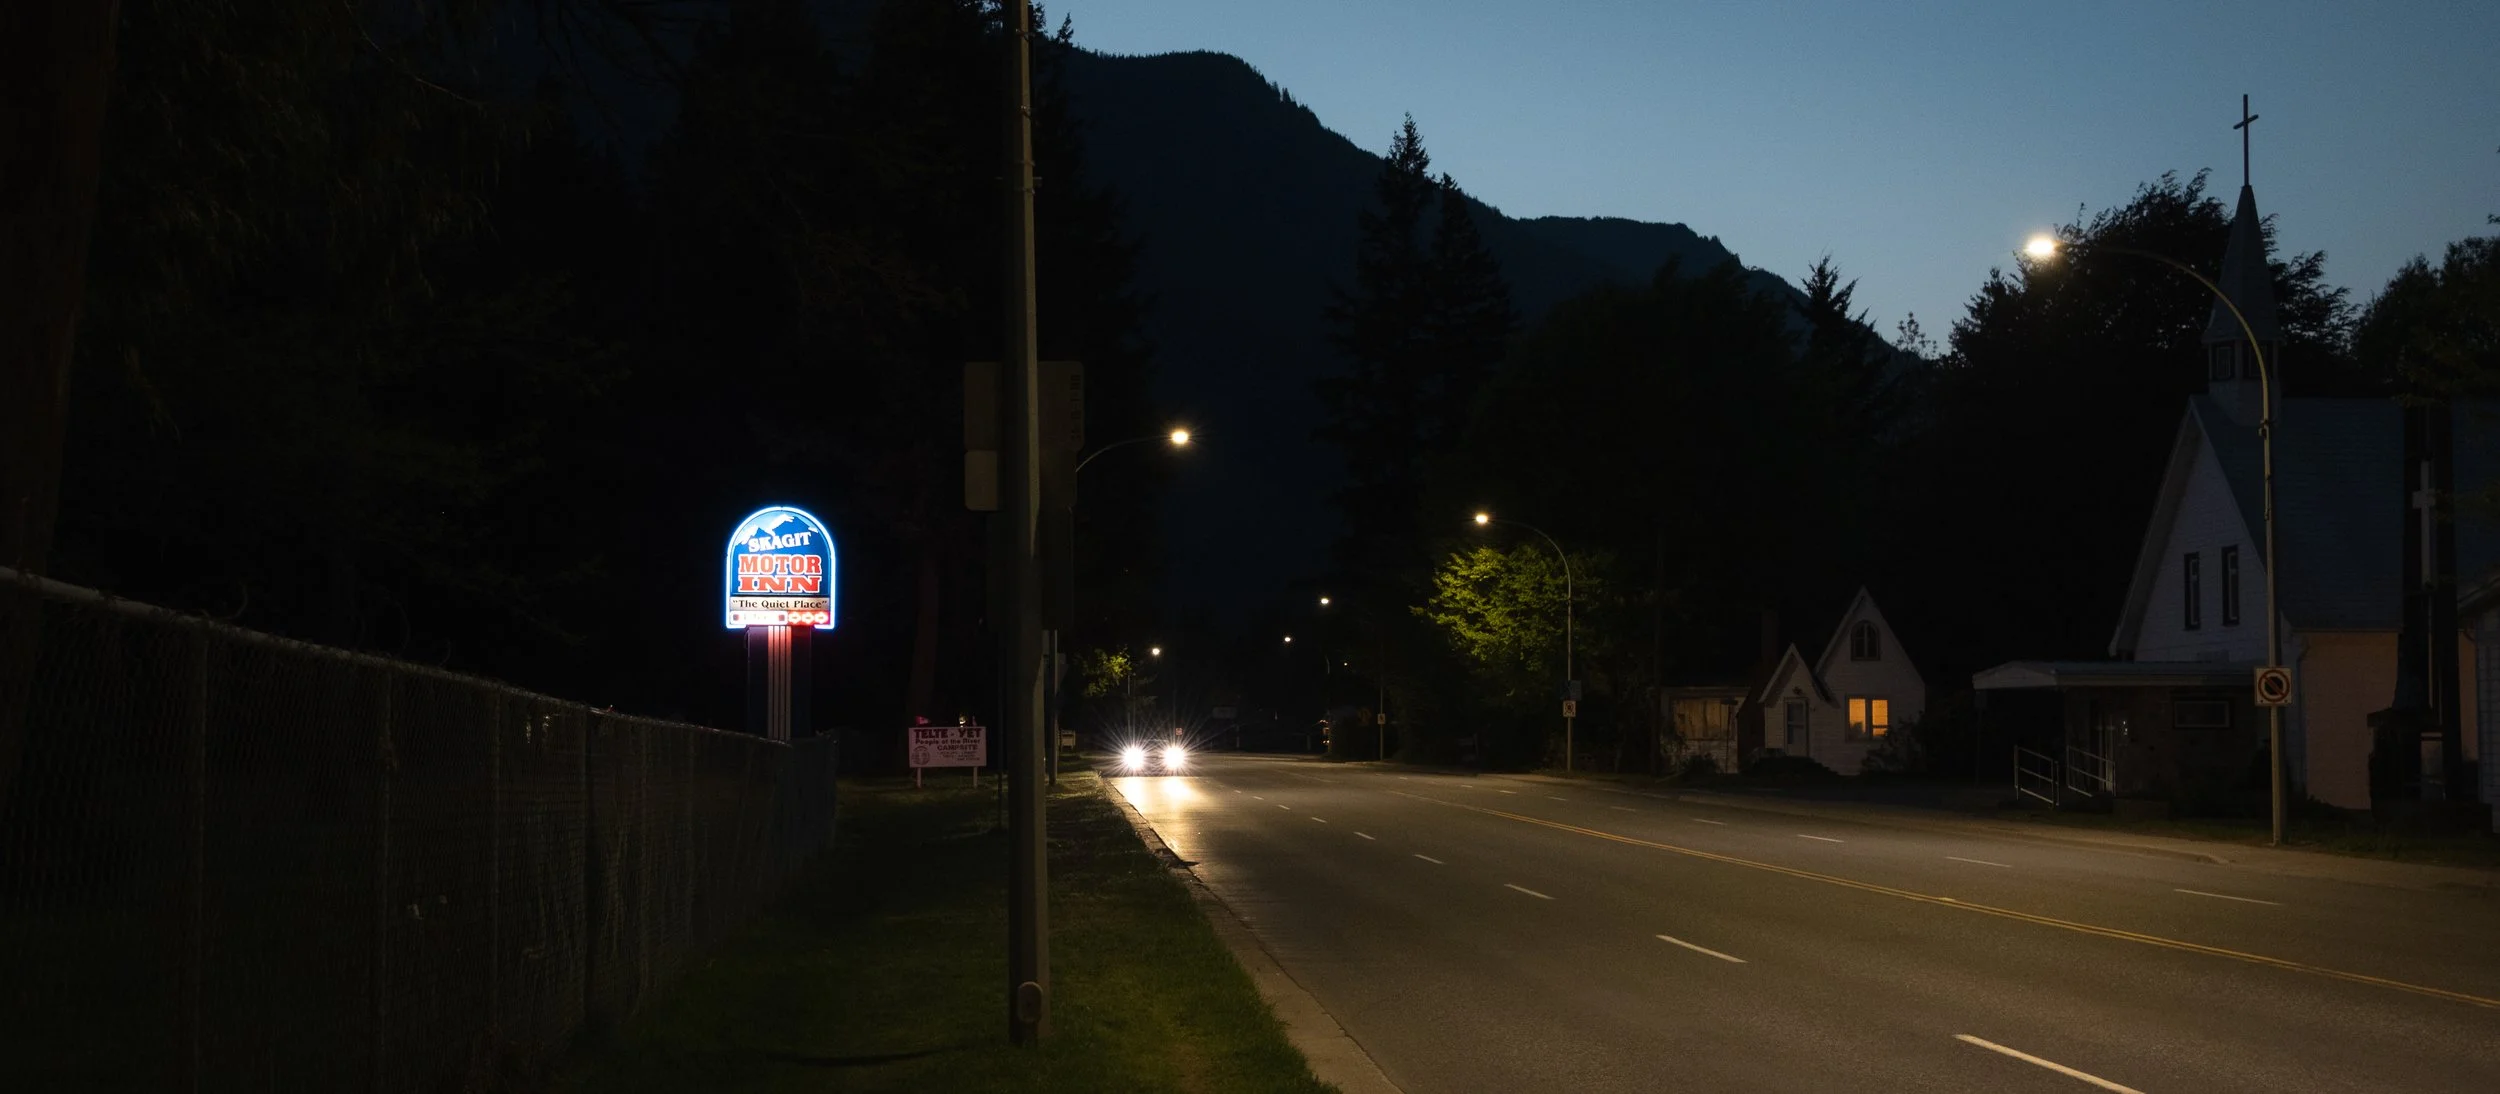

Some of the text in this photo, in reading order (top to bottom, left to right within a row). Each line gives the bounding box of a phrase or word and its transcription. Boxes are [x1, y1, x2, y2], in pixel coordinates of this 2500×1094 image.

[748, 532, 812, 553] SKAGIT
[739, 554, 822, 574] MOTOR
[739, 576, 821, 592] INN
[761, 599, 790, 609] Quiet
[914, 728, 948, 738] TELTE
[915, 738, 939, 746] People
